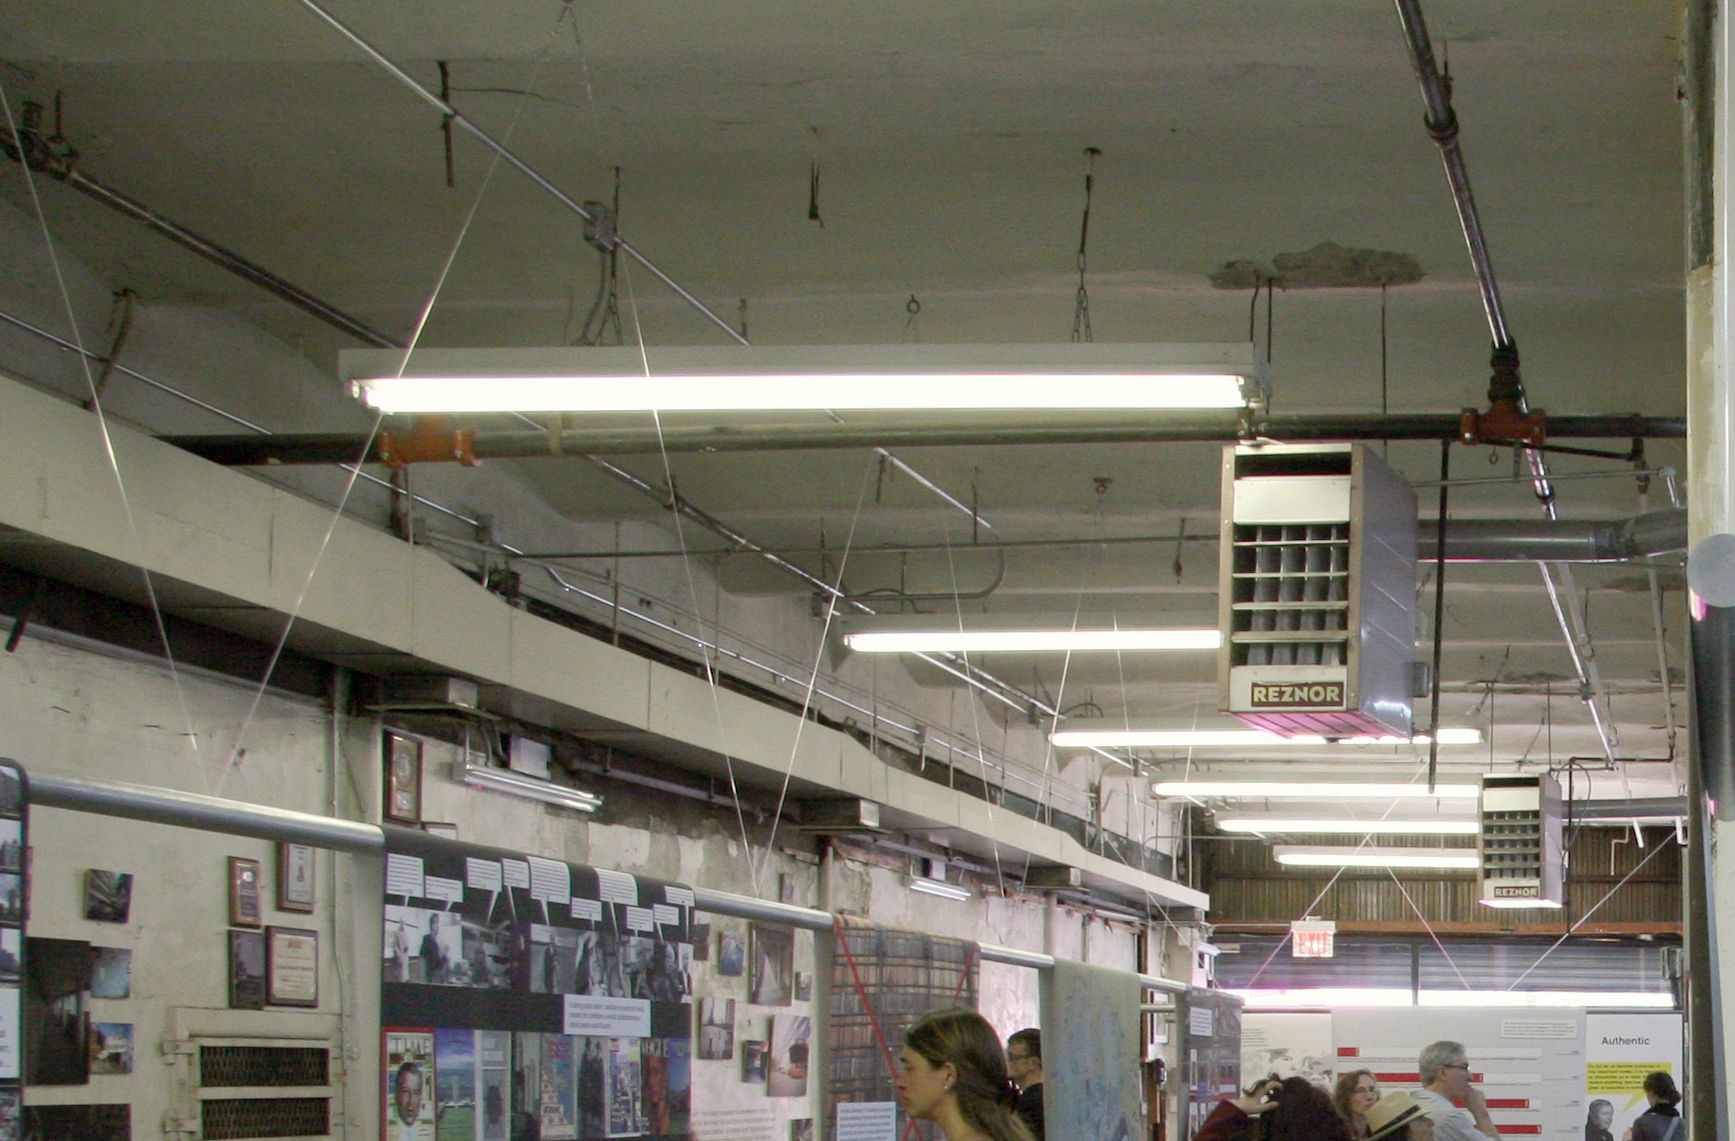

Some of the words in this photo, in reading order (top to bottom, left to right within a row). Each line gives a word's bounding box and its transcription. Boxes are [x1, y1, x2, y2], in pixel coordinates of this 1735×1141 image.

[1253, 686, 1340, 702] REZNOR
[1495, 887, 1537, 897] REZNOR
[1601, 1036, 1650, 1045] Authentic
